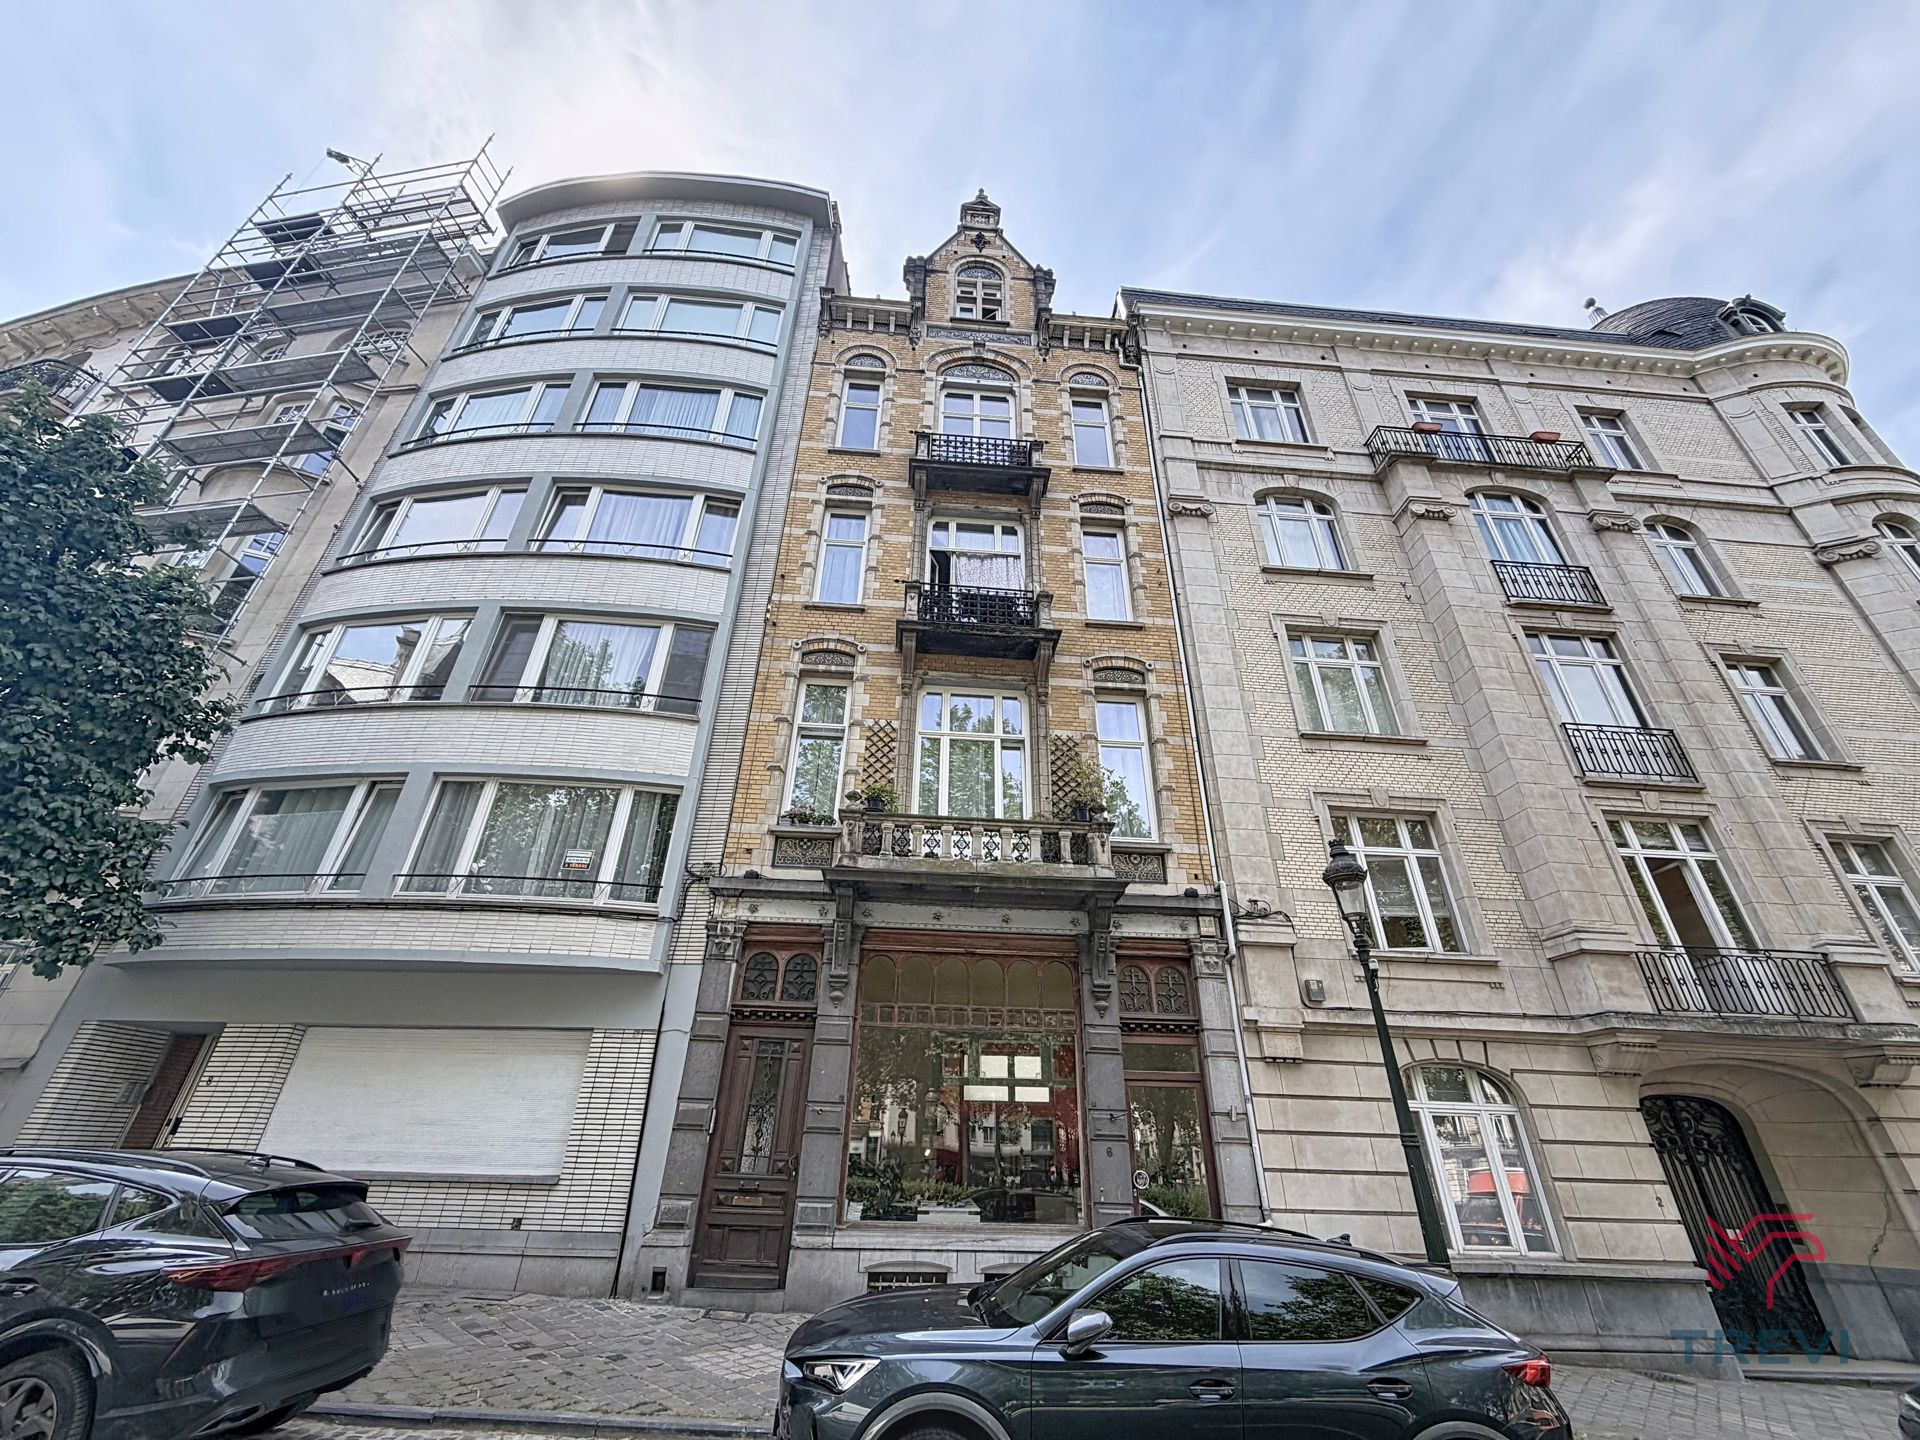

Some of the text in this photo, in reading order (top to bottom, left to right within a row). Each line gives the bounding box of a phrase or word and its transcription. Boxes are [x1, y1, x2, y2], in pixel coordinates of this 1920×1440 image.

[206, 1076, 213, 1086] 8
[1106, 1146, 1113, 1157] 6
[1655, 1196, 1664, 1207] 2
